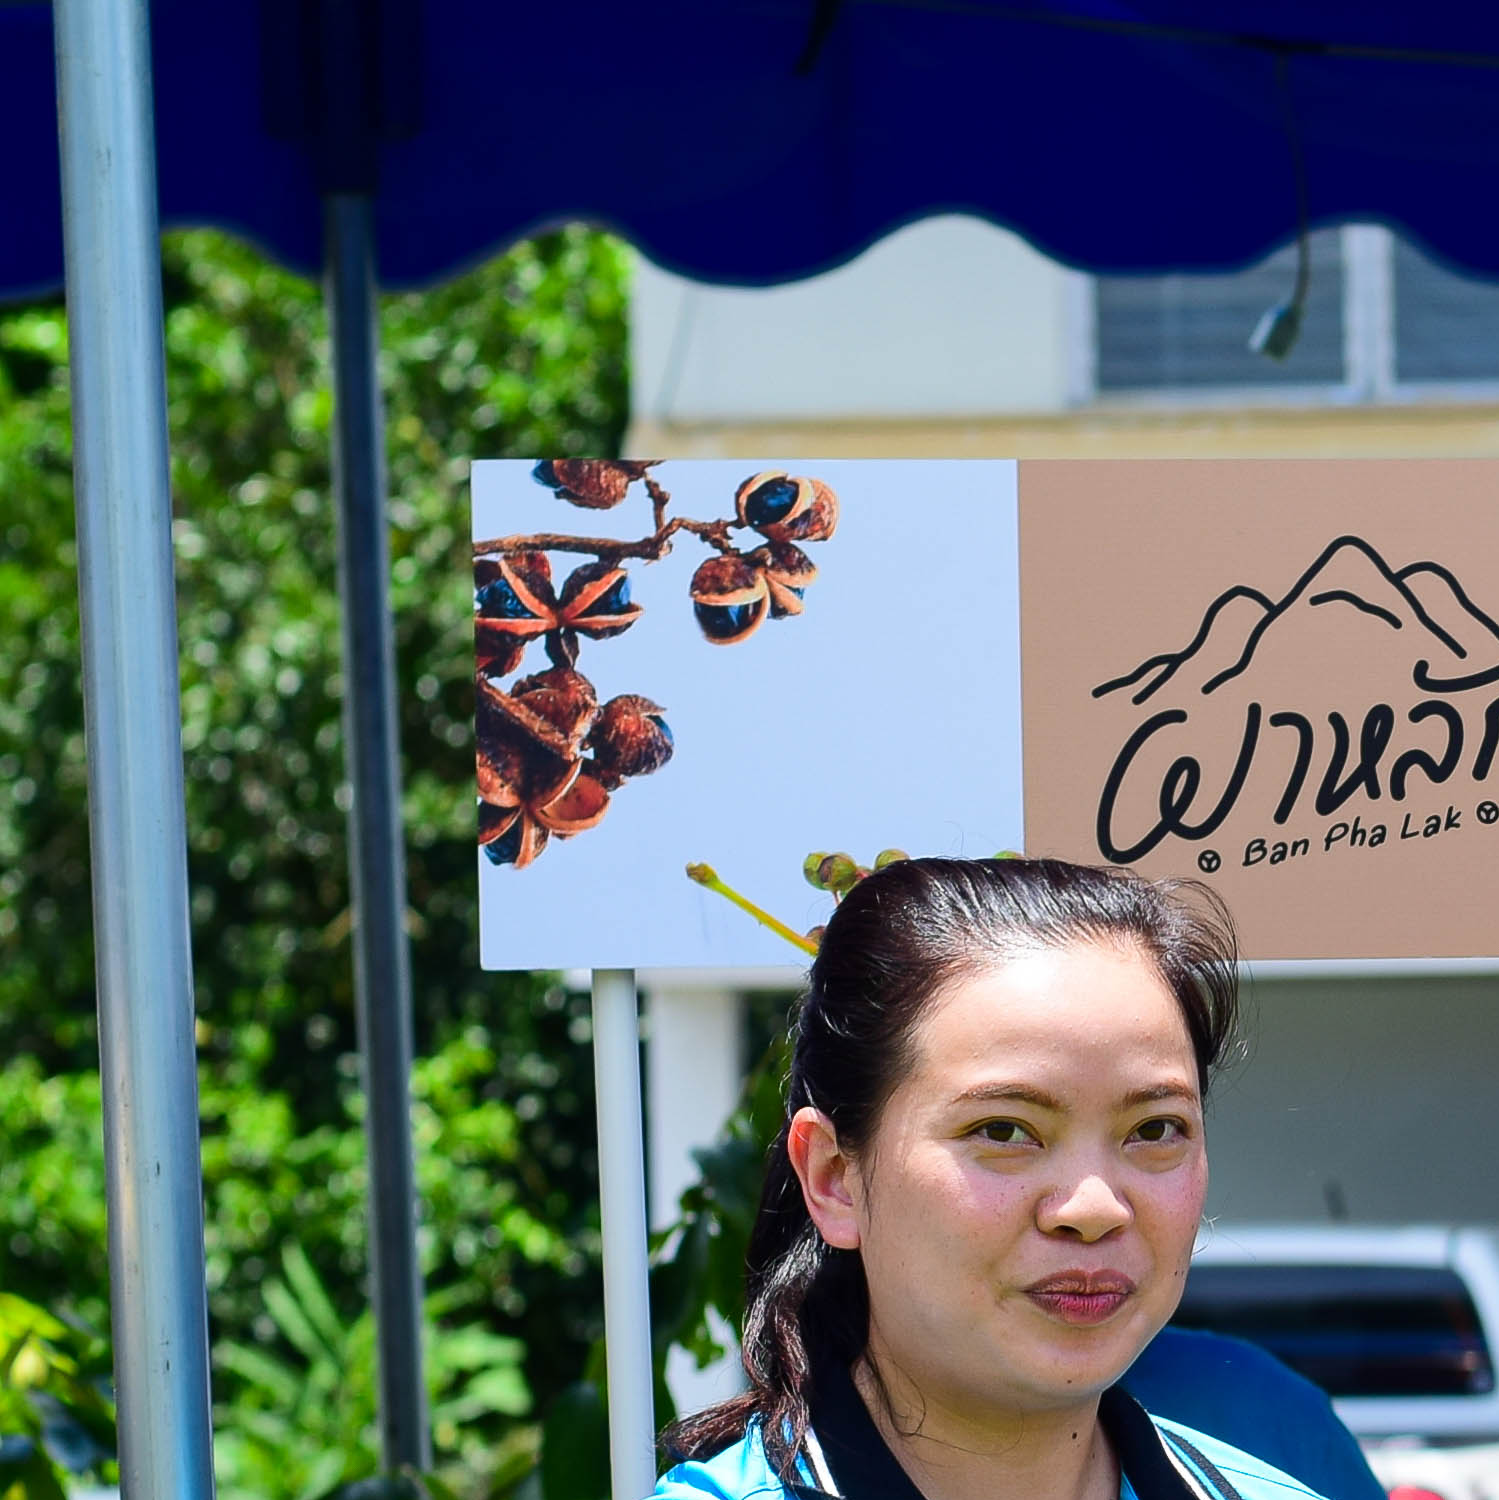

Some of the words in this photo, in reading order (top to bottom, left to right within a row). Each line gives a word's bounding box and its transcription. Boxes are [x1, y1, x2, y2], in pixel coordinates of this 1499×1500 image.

[1242, 837, 1309, 868] Ban
[1324, 820, 1387, 853] Pha
[1400, 805, 1462, 841] Lak
